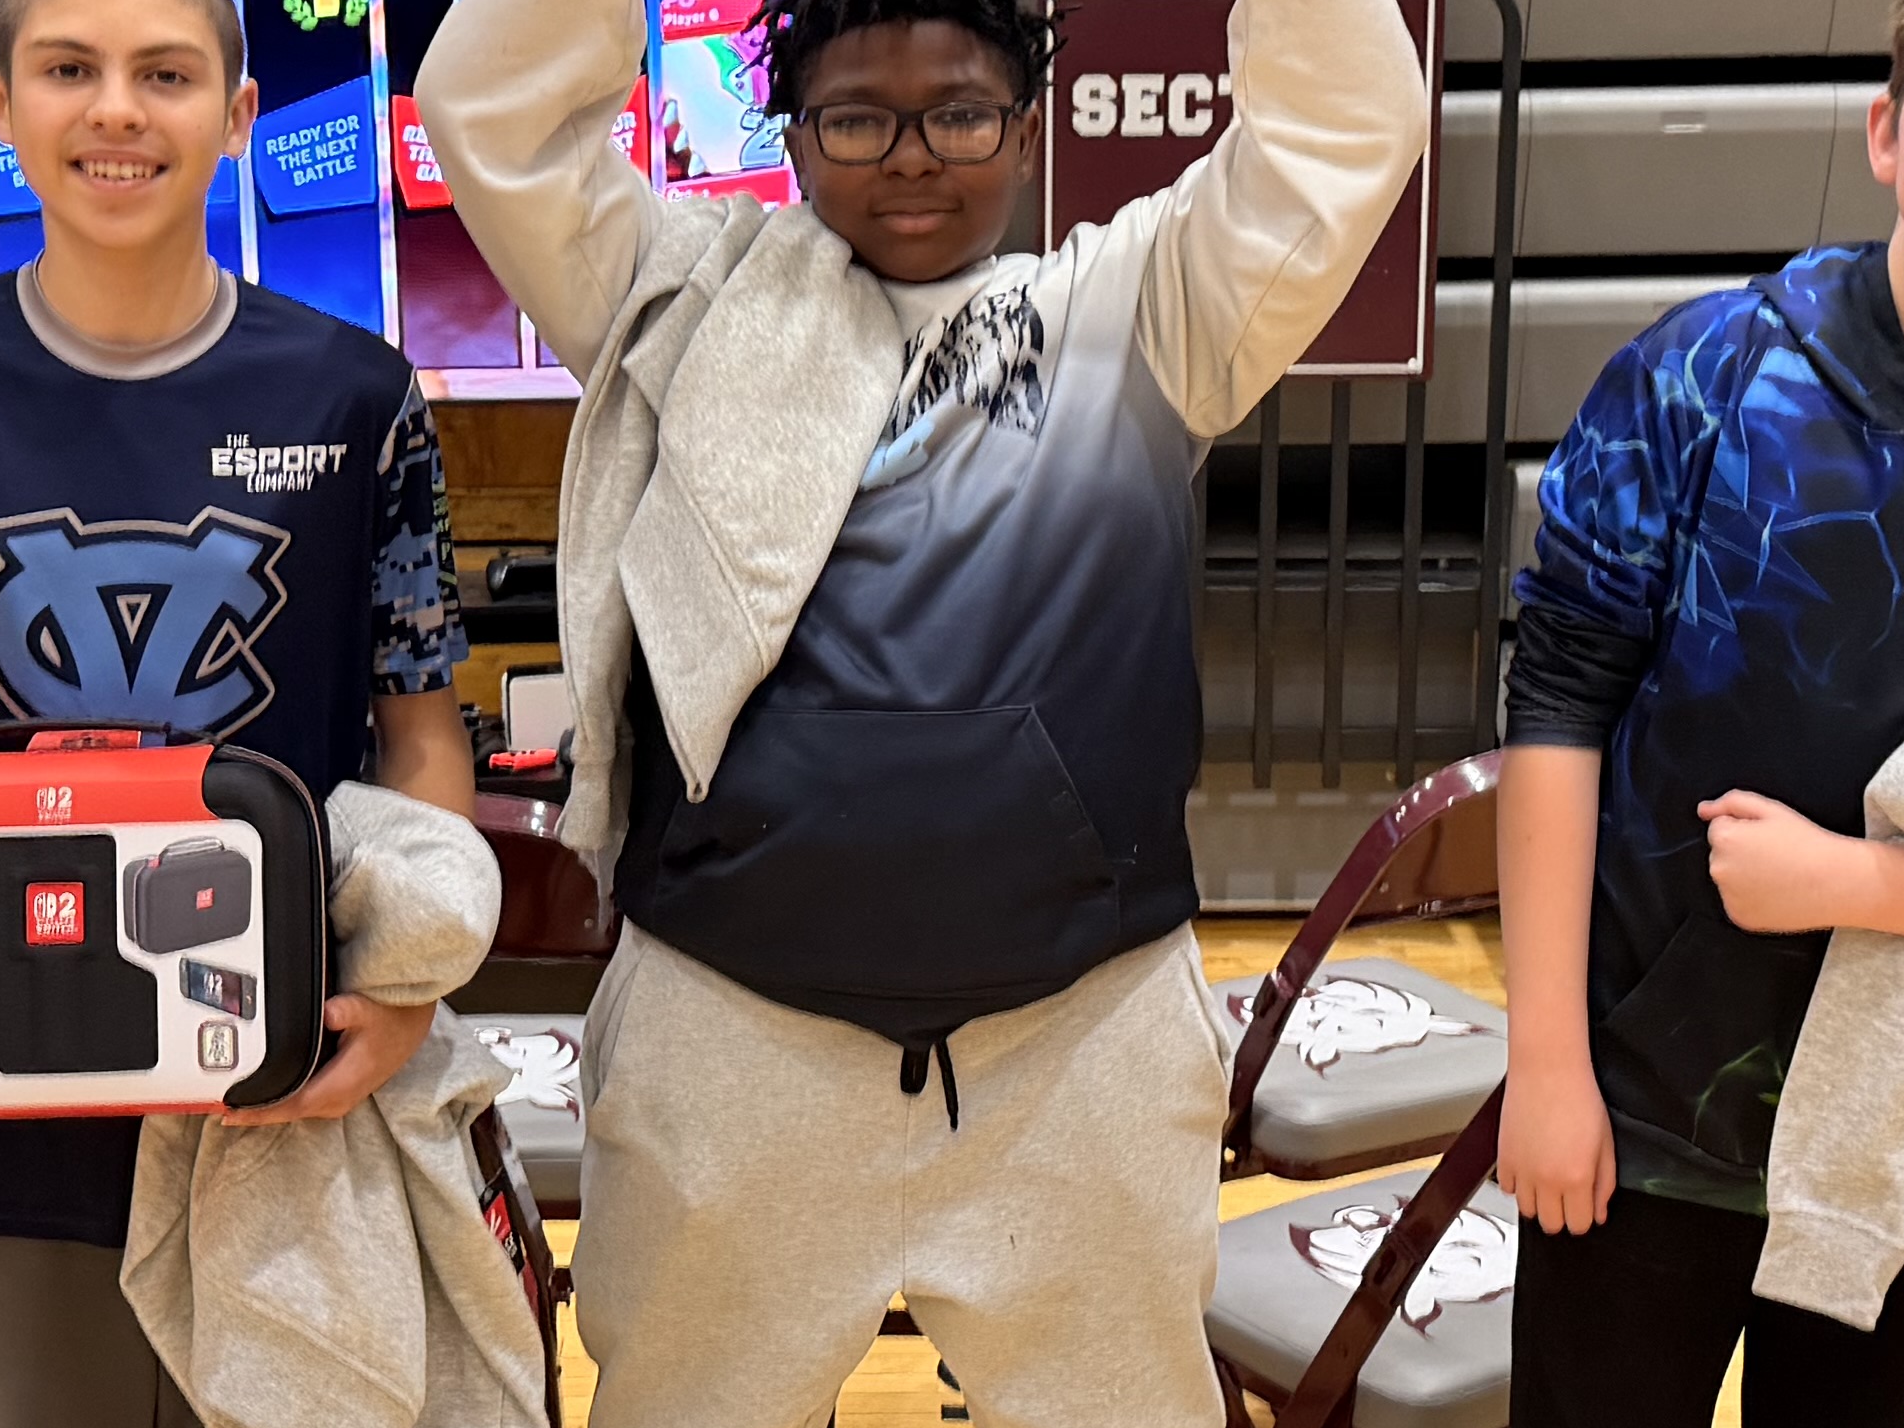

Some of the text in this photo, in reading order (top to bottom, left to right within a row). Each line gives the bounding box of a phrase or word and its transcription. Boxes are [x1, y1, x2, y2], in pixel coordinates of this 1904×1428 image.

[1071, 72, 1233, 138] SEC
[266, 115, 360, 154] READY FOR
[277, 135, 358, 171] THE NEXT
[293, 156, 357, 187] BATTLE
[226, 433, 250, 448] THE
[211, 443, 347, 477] ESPORT
[246, 469, 315, 493] COMPANY
